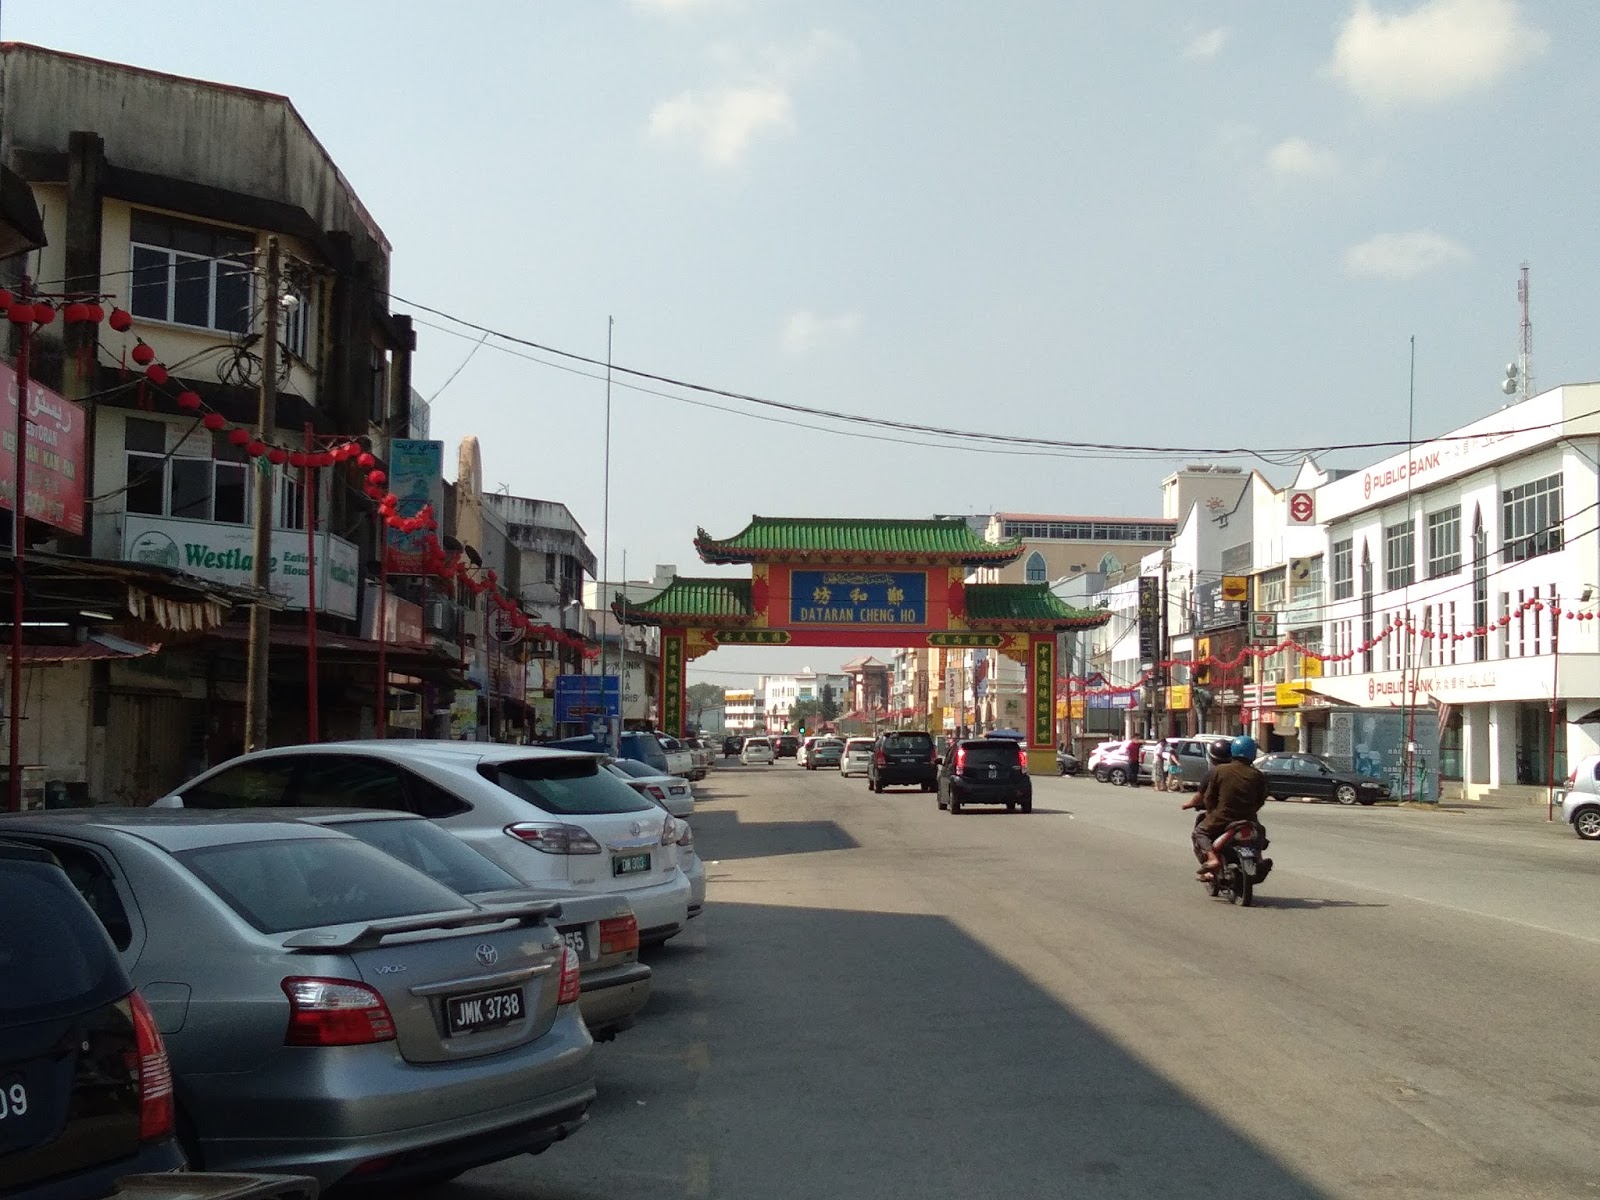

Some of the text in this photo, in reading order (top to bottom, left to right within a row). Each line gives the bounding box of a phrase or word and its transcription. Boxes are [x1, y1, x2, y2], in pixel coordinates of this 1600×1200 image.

[26, 420, 58, 447] ESTORAN
[1373, 450, 1440, 490] PUBLIC BANK
[185, 543, 277, 573] Westlae
[800, 607, 916, 622] DATARAN CHENG HO
[1377, 678, 1433, 695] PUBLIC BANK
[375, 964, 407, 975] VIOS
[457, 993, 520, 1026] JMK 3738
